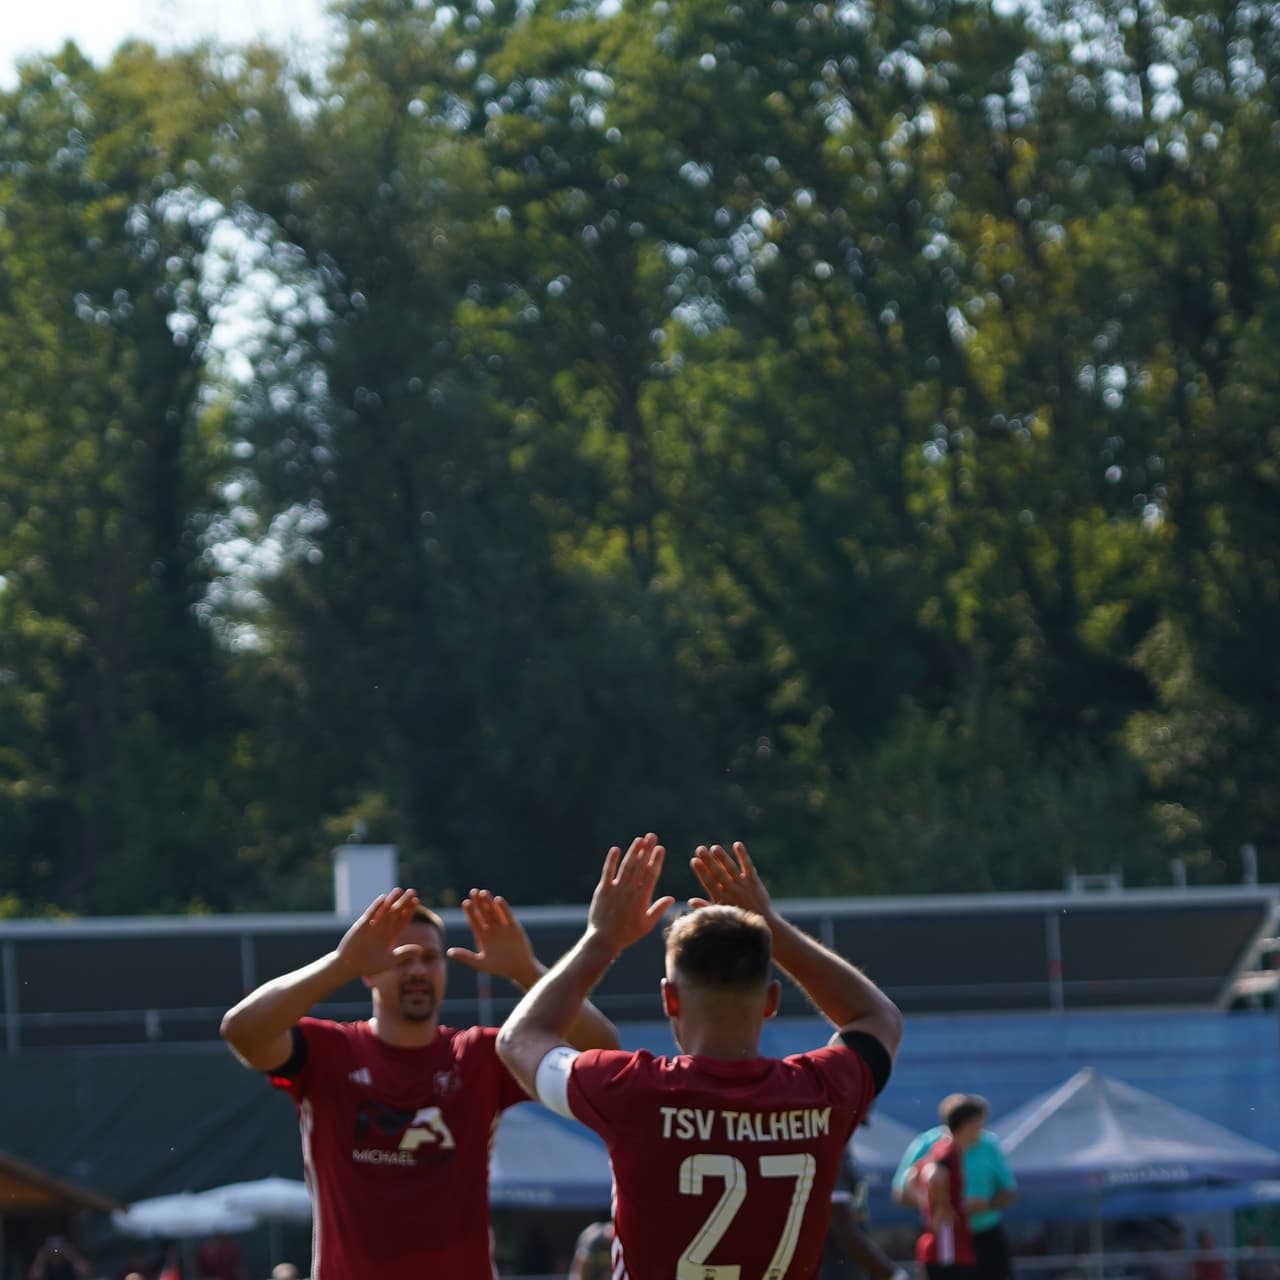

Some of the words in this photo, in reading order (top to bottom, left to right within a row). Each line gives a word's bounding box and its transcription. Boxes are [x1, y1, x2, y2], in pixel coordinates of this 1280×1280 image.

[660, 1107, 715, 1141] TSV
[722, 1107, 832, 1142] TALHEIM
[352, 1148, 417, 1166] MICHAEL
